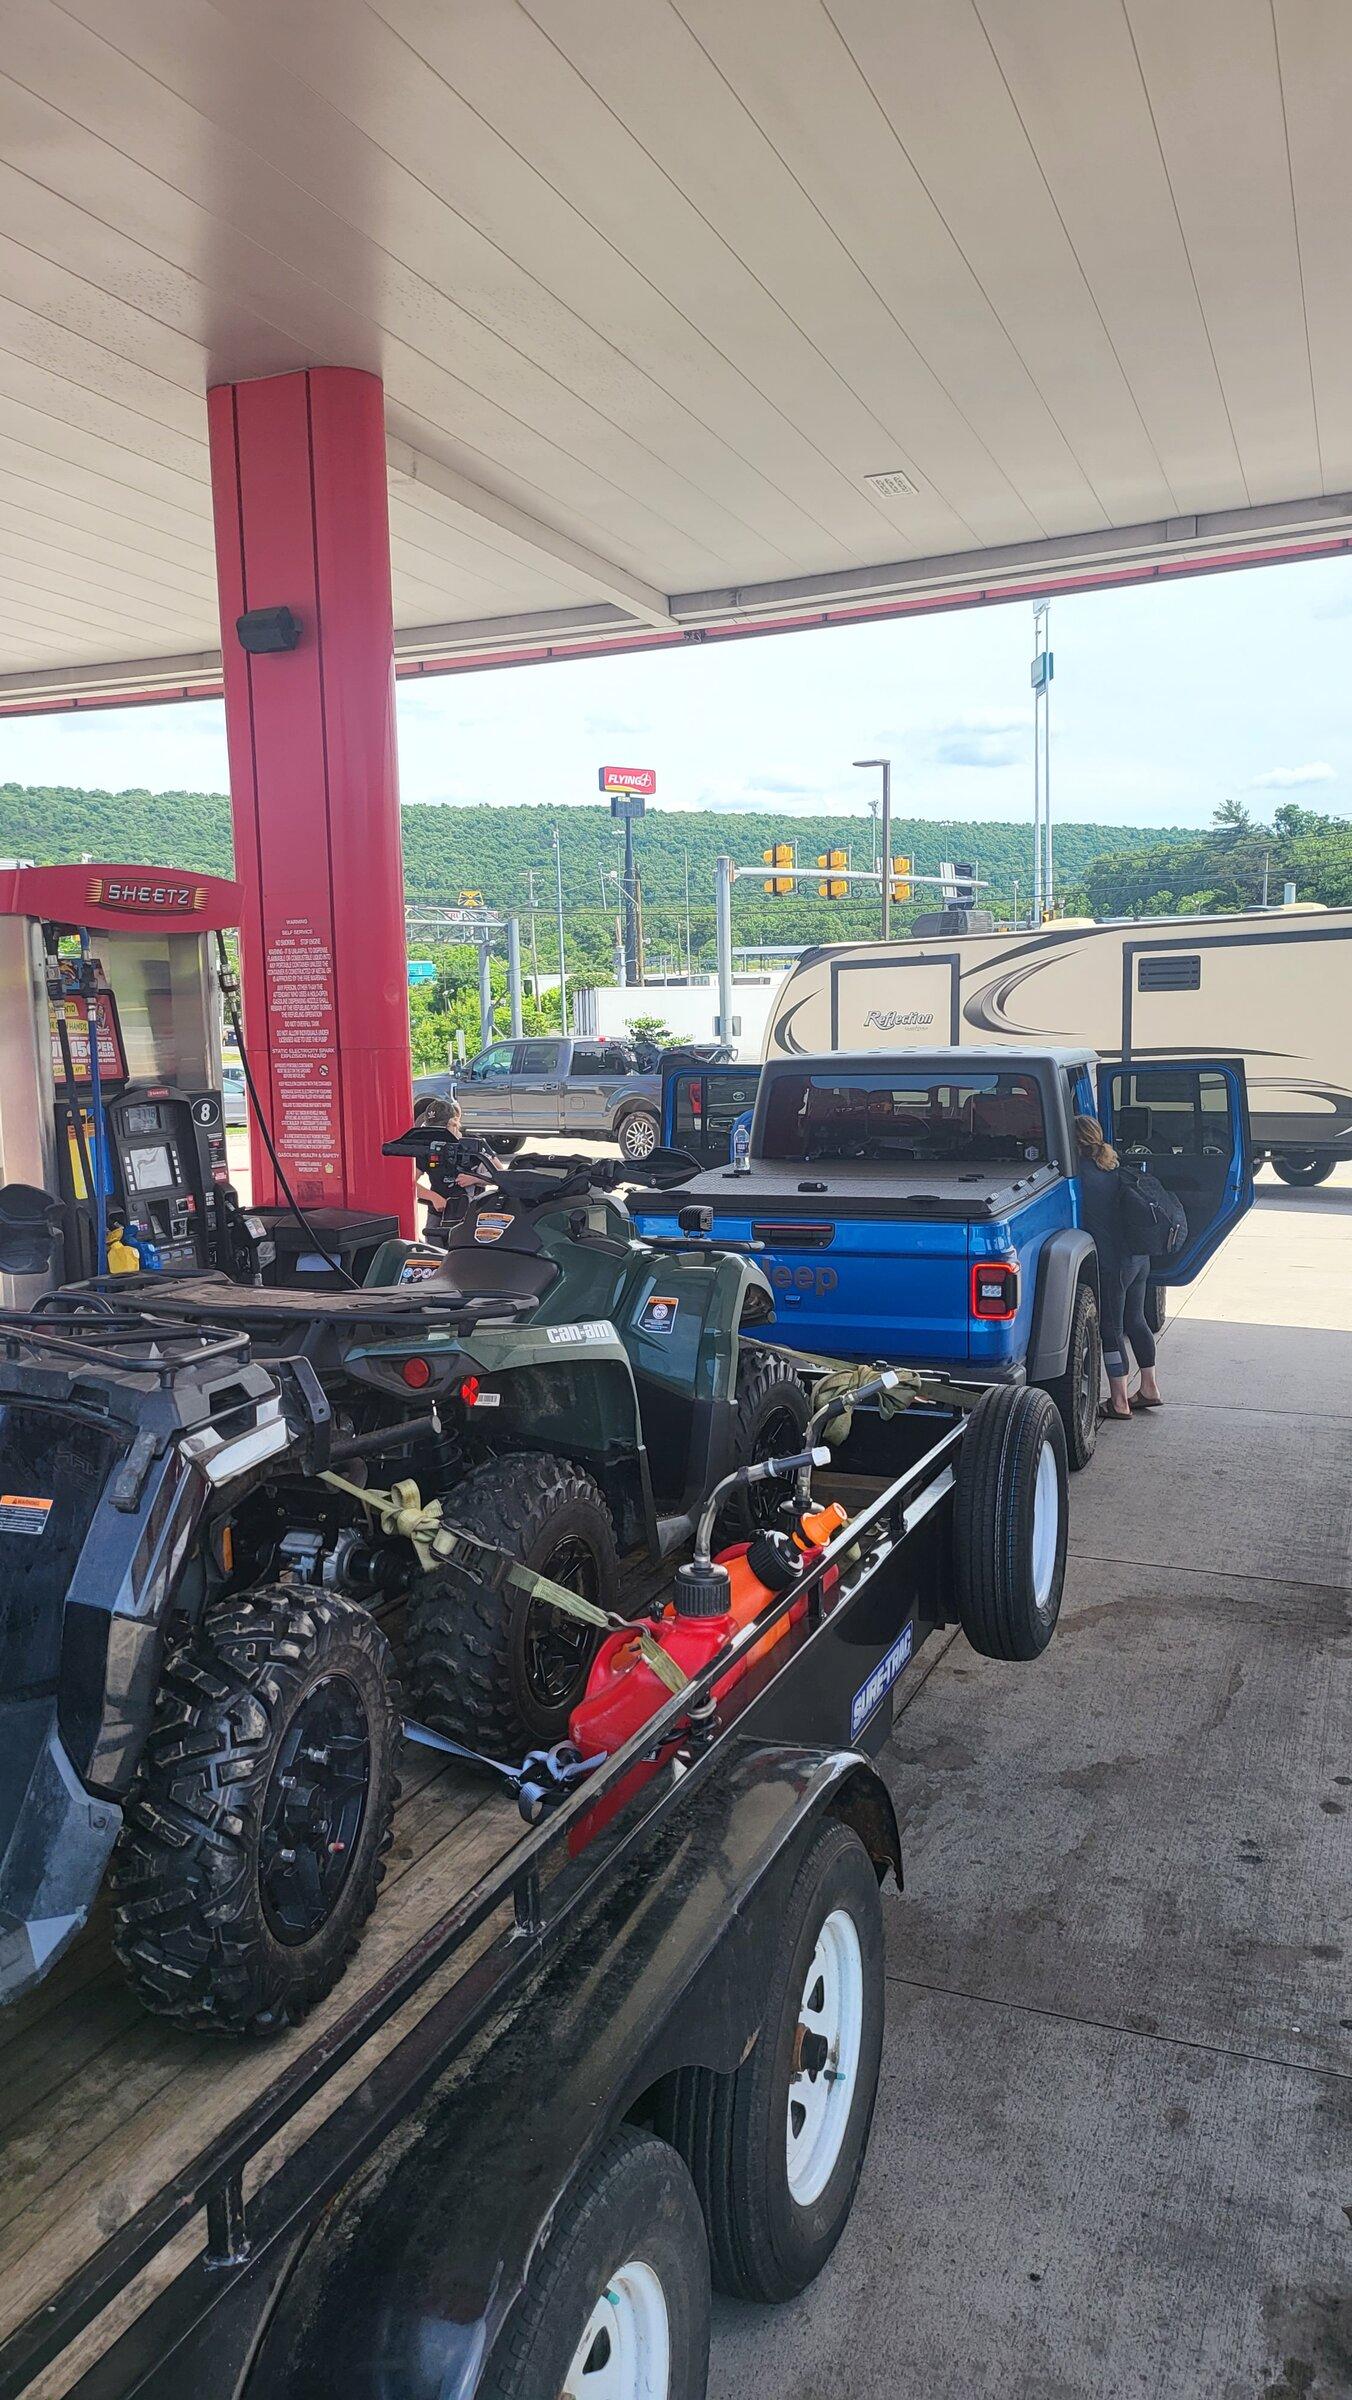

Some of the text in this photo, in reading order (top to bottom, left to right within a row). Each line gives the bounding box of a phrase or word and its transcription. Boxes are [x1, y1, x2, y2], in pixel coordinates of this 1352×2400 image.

[607, 773, 641, 785] FLYING
[108, 884, 190, 905] SHEETZ
[863, 1010, 934, 1031] Reflection
[200, 1103, 211, 1122] 8
[762, 1258, 838, 1296] Jeep
[546, 1323, 610, 1343] can-am
[853, 1628, 912, 1730] SURE-TRAC
